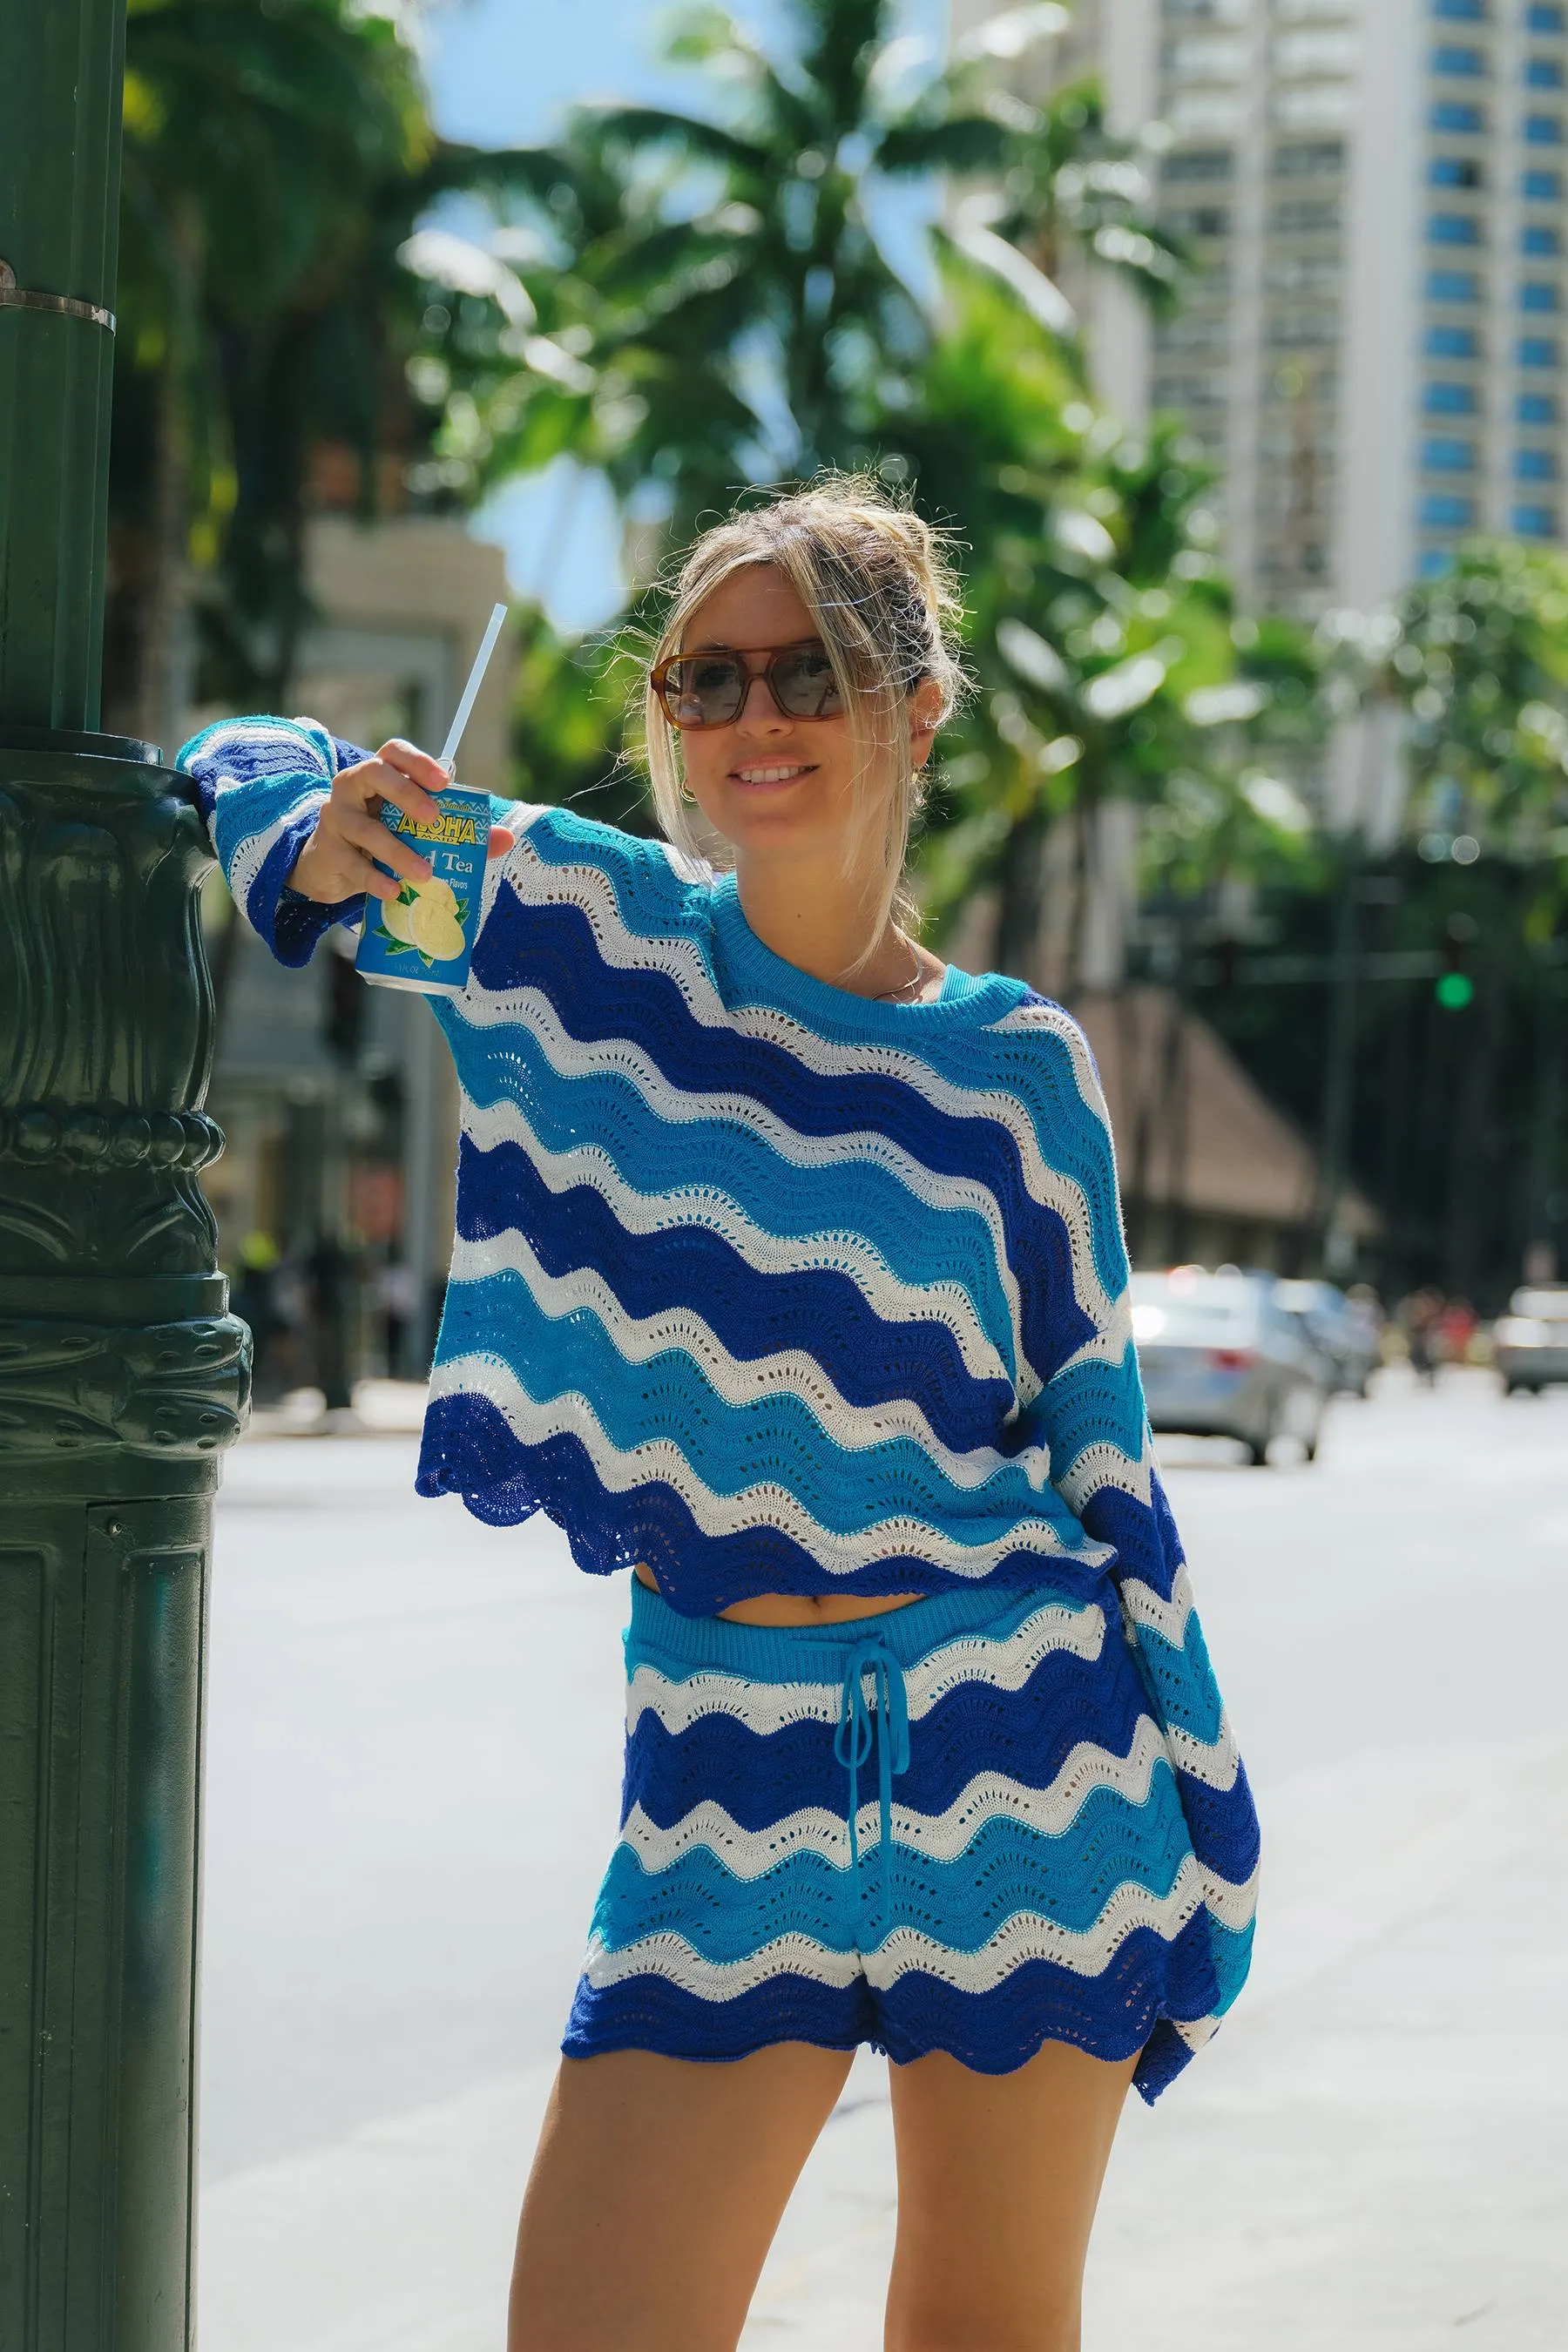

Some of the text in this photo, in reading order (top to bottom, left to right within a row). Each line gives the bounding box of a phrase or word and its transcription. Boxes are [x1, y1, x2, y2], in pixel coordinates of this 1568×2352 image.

[421, 834, 454, 842] MAID
[442, 852, 473, 873] Tea
[449, 878, 468, 889] Flavors
